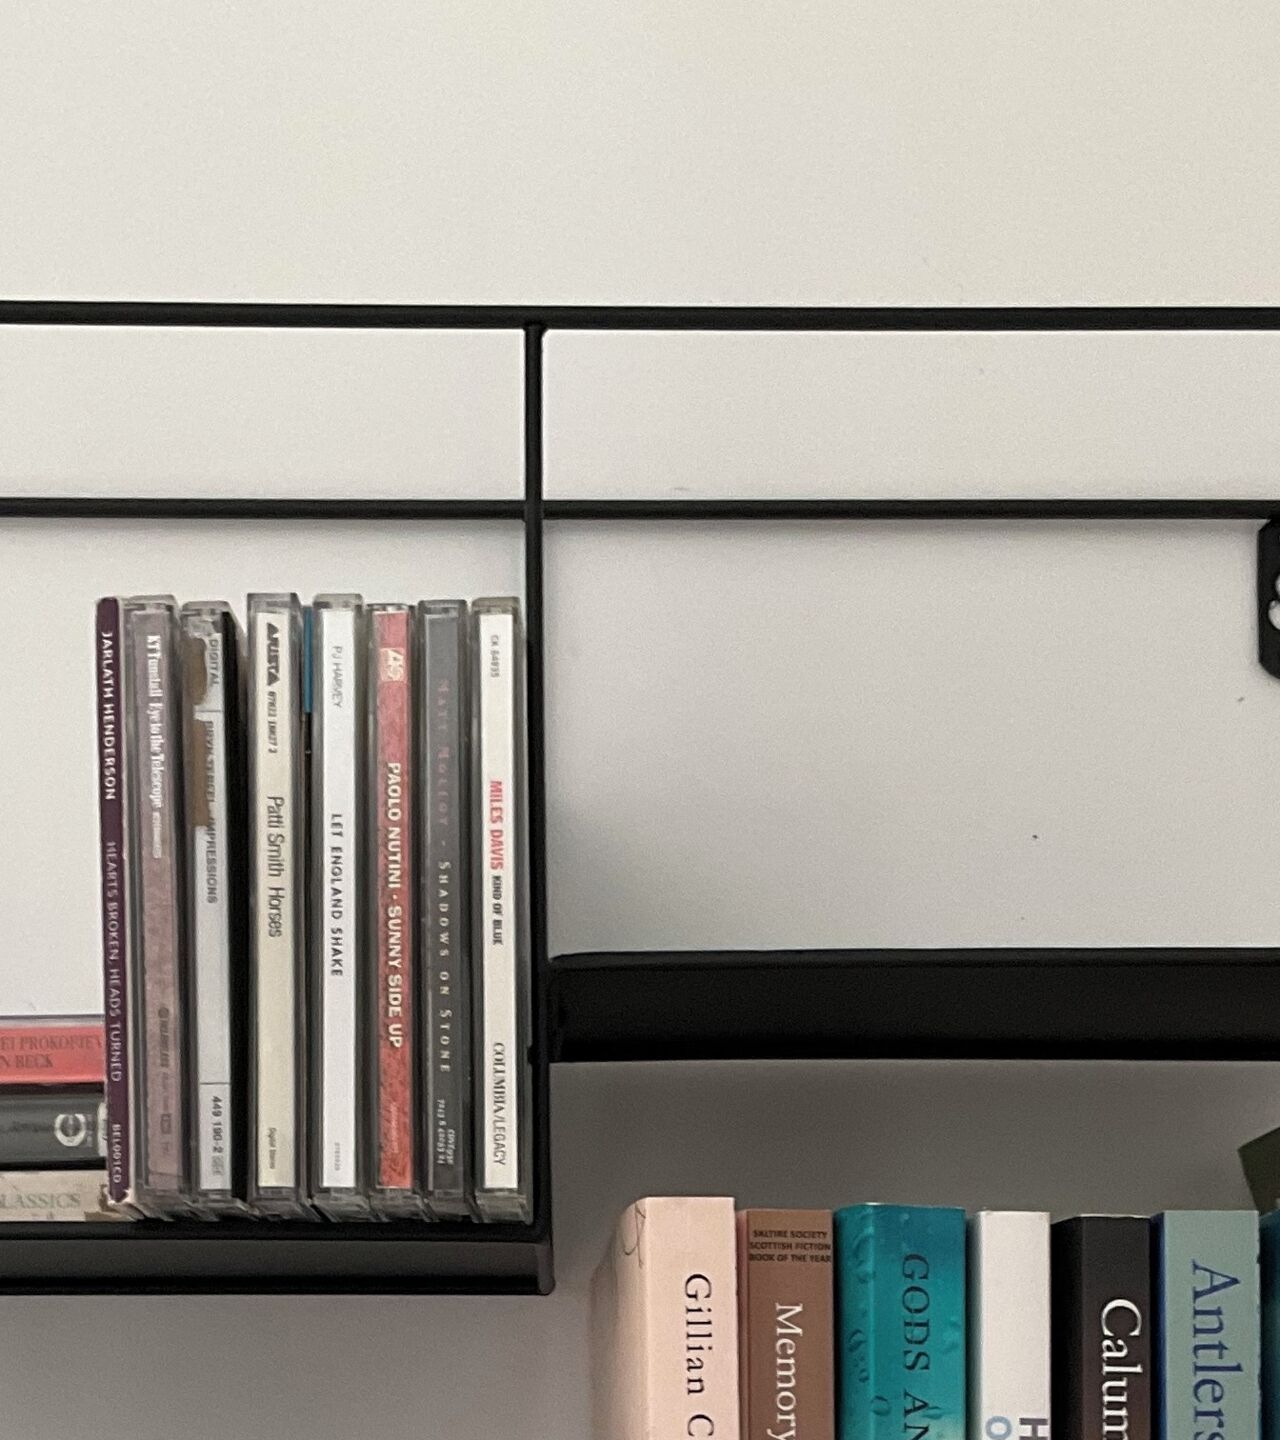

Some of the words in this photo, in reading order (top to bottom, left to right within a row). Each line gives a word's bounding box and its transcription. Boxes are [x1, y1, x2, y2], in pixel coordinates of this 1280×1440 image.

[146, 635, 161, 651] KT
[209, 638, 220, 688] DIGITAL
[267, 622, 281, 687] ARISTA
[333, 646, 343, 660] PJ
[489, 635, 500, 648] CK
[101, 632, 115, 698] JARLATH
[148, 653, 163, 698] Tunstall
[333, 664, 344, 709] HARVEY
[147, 703, 163, 722] Eye
[438, 679, 450, 731] MATT
[148, 723, 161, 735] to
[149, 735, 164, 753] the
[103, 703, 117, 801] HENDERSON
[149, 754, 166, 809] Telescope
[387, 763, 402, 820] PAOLO
[438, 745, 450, 827] MOLLOY
[489, 780, 504, 826] MILES
[267, 796, 284, 829] Patti
[330, 814, 344, 839] LET
[106, 842, 119, 898] HEARTS
[205, 817, 219, 905] IMPRESSIONS
[267, 833, 285, 878] Smith
[388, 827, 402, 889] NUTINI
[490, 829, 504, 870] DAVIS
[330, 847, 344, 919] ENGLAND
[491, 875, 503, 901] KIND
[268, 888, 285, 937] Horses
[438, 861, 451, 957] SHADOWS
[492, 903, 503, 916] OF
[107, 902, 120, 964] BROKEN,
[330, 927, 344, 977] SHAKE
[388, 905, 403, 968] SUNNY
[492, 919, 504, 946] BLUE
[108, 968, 121, 1017] HEADS
[388, 974, 403, 1017] SIDE
[439, 971, 450, 995] ON
[109, 1022, 122, 1082] TURNED
[389, 1024, 404, 1048] UP
[440, 1008, 453, 1073] STONE
[15, 1054, 54, 1068] BECK
[211, 1096, 223, 1117] 449
[493, 1042, 506, 1165] COLUMBIA/LEGACY
[211, 1121, 223, 1153] 190-2
[750, 1242, 792, 1250] SCOTTISH
[790, 1231, 827, 1239] SOCIETY
[777, 1254, 788, 1262] OF
[684, 1272, 714, 1397] Gillian
[902, 1253, 931, 1372] GODS
